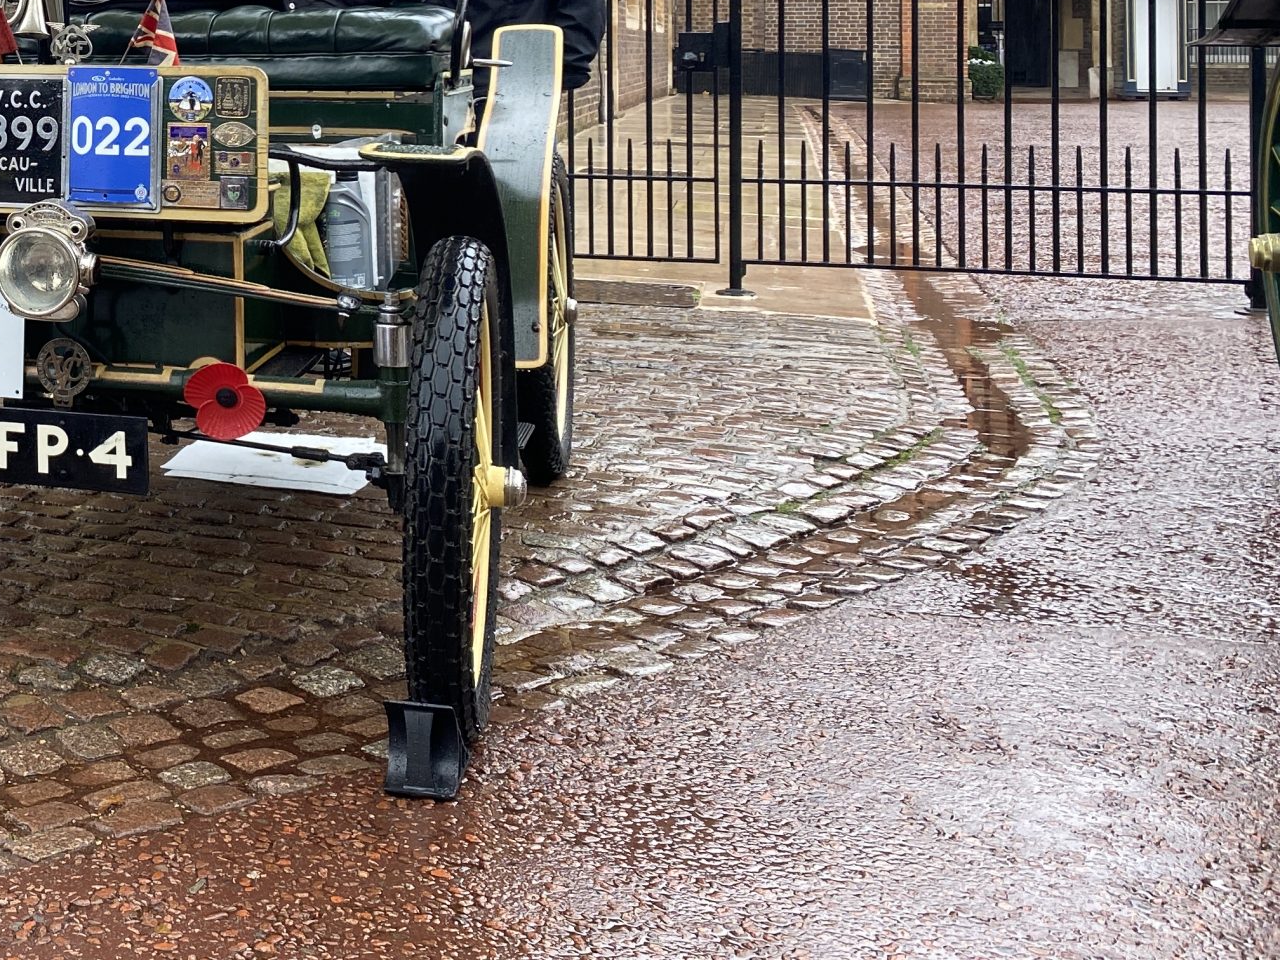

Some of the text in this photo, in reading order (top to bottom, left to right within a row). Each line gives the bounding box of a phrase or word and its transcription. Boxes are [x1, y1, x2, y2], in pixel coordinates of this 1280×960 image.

[73, 82, 150, 99] LONDON TO BRIGHTON
[71, 116, 150, 156] 022
[15, 177, 55, 193] VILLE
